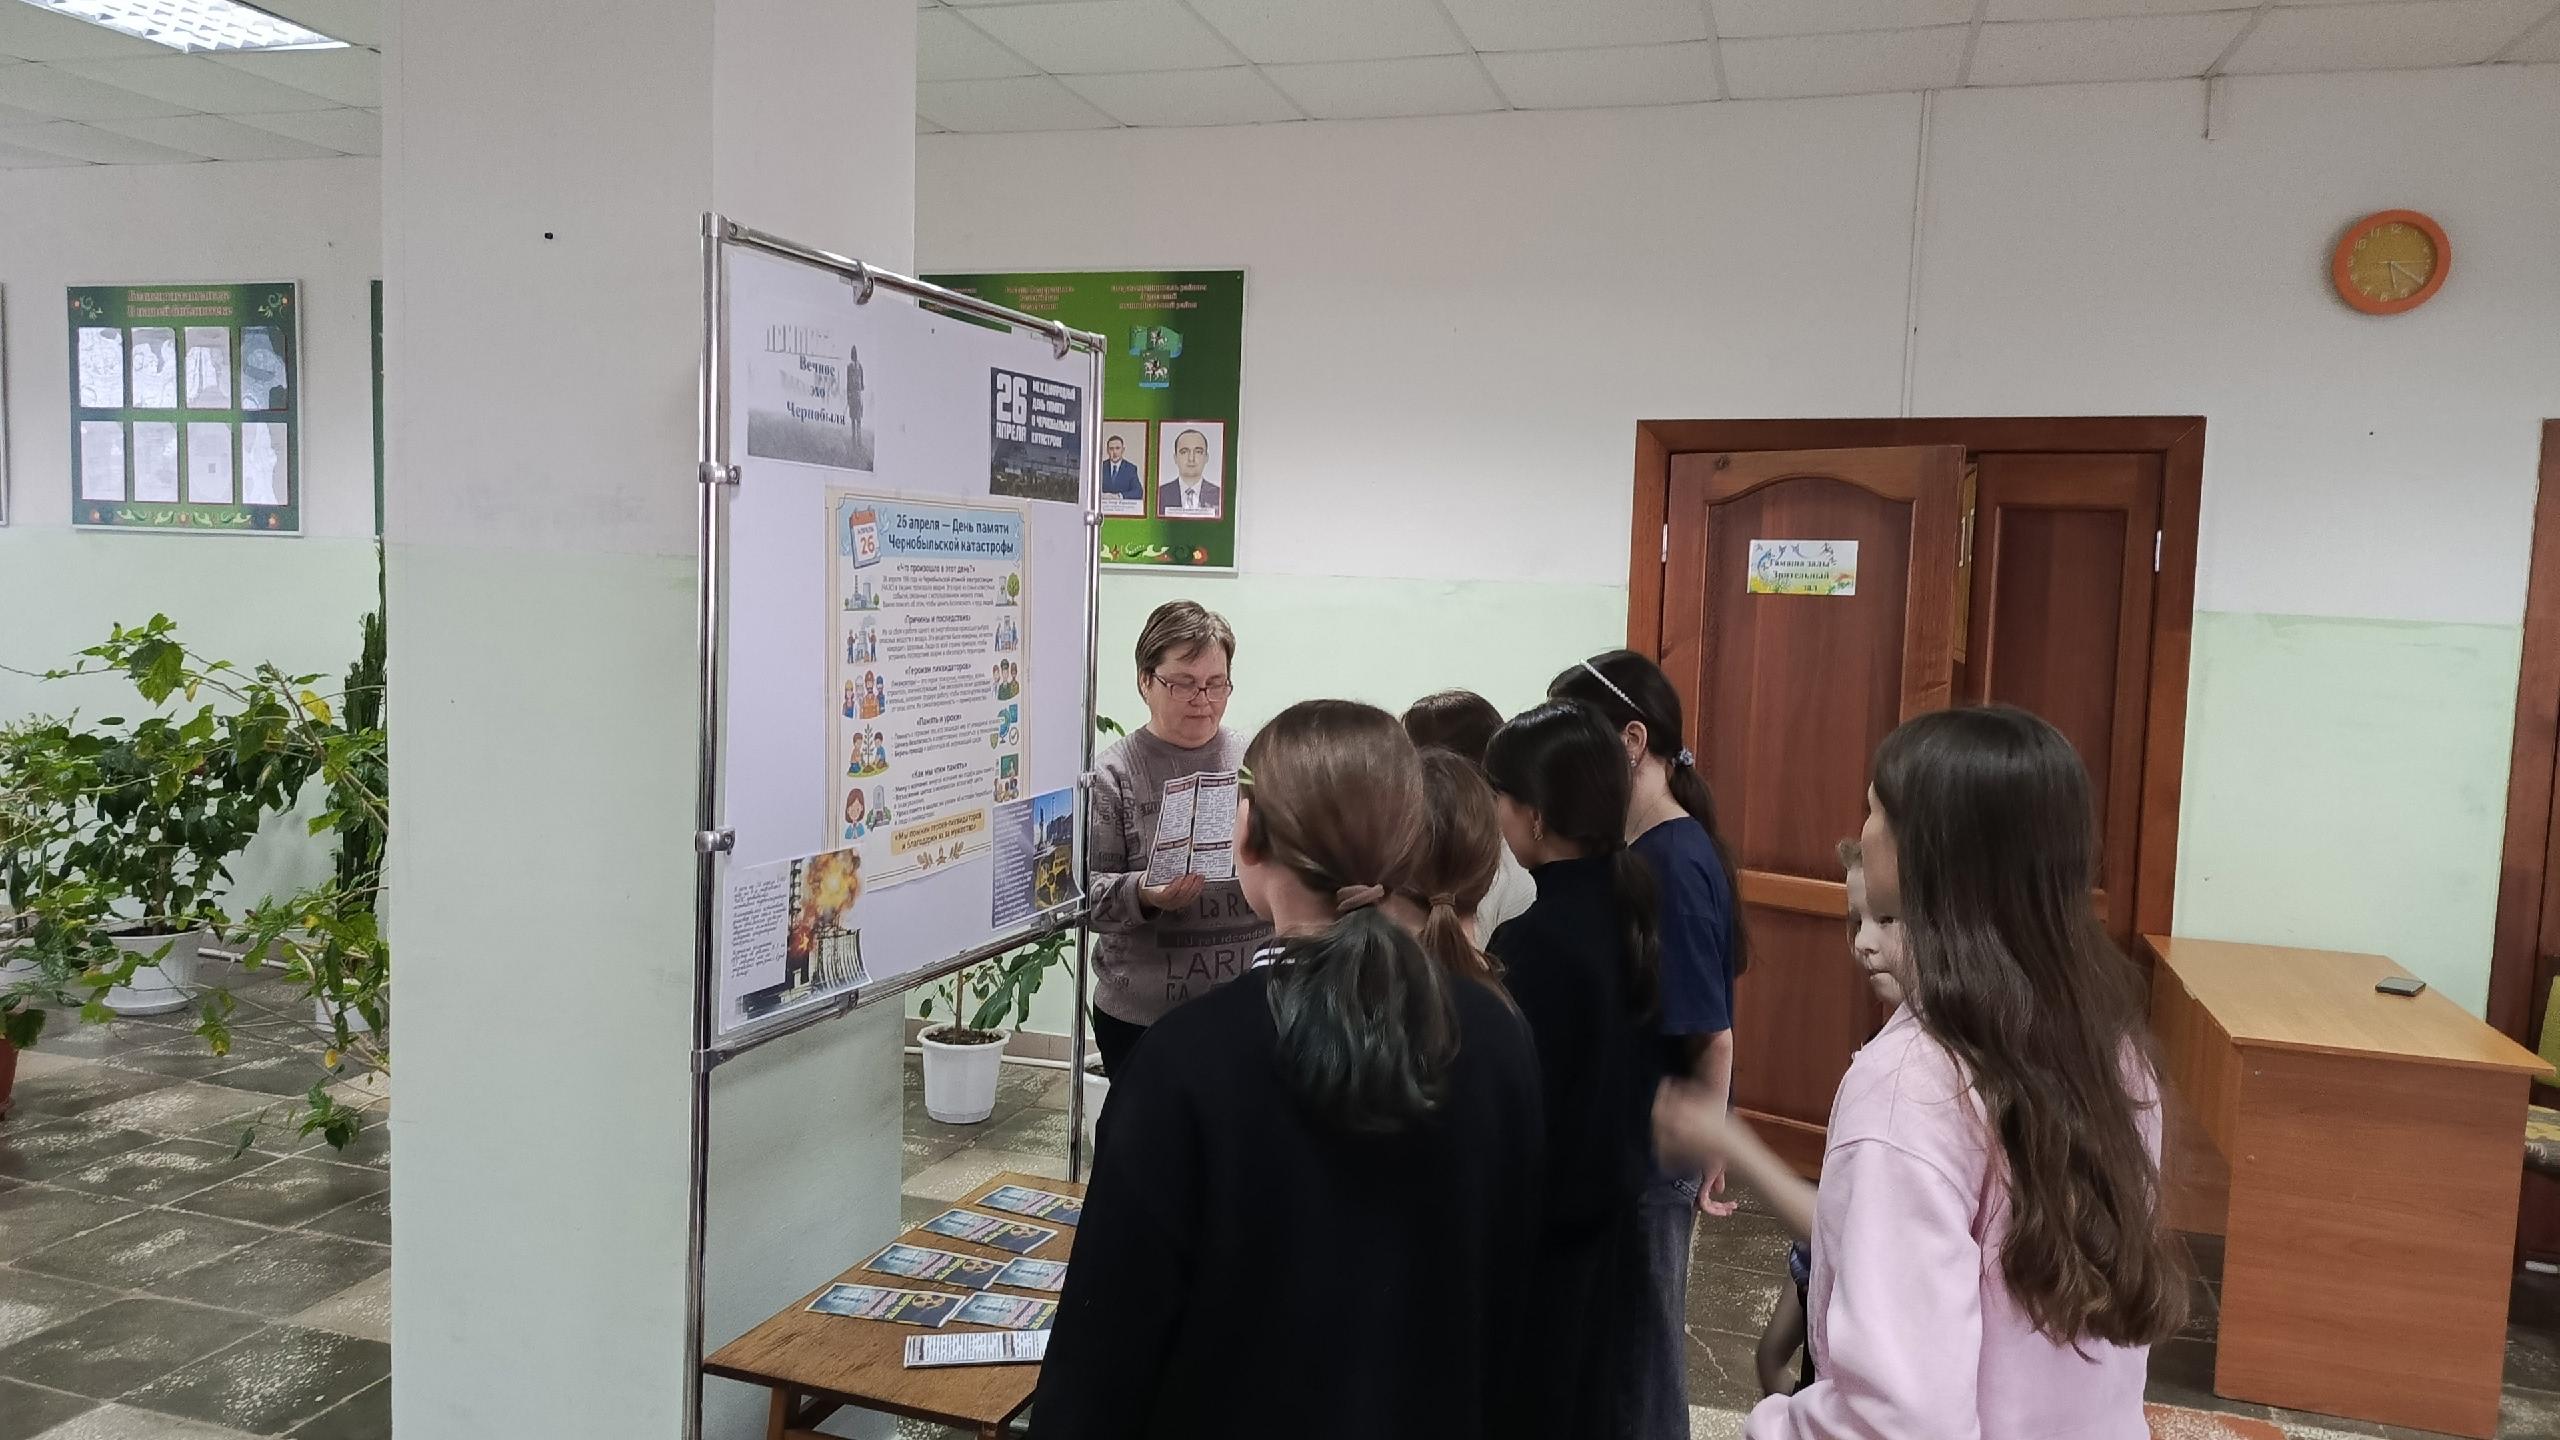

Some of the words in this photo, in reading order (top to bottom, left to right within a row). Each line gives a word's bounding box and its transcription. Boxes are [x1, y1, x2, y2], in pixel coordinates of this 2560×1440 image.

[799, 355, 836, 376] Вечное
[809, 386, 826, 399] эхо
[996, 373, 1027, 425] 26
[786, 400, 846, 426] Чернобыля
[996, 421, 1027, 442] АПРЕЛЯ
[897, 514, 908, 528] 26
[909, 516, 940, 532] апреля
[952, 518, 974, 534] День
[976, 522, 1009, 535] памяти
[860, 535, 875, 555] 26
[888, 534, 959, 553] Чернобыльской
[960, 540, 1014, 556] катастрофы
[1200, 896, 1220, 919] La
